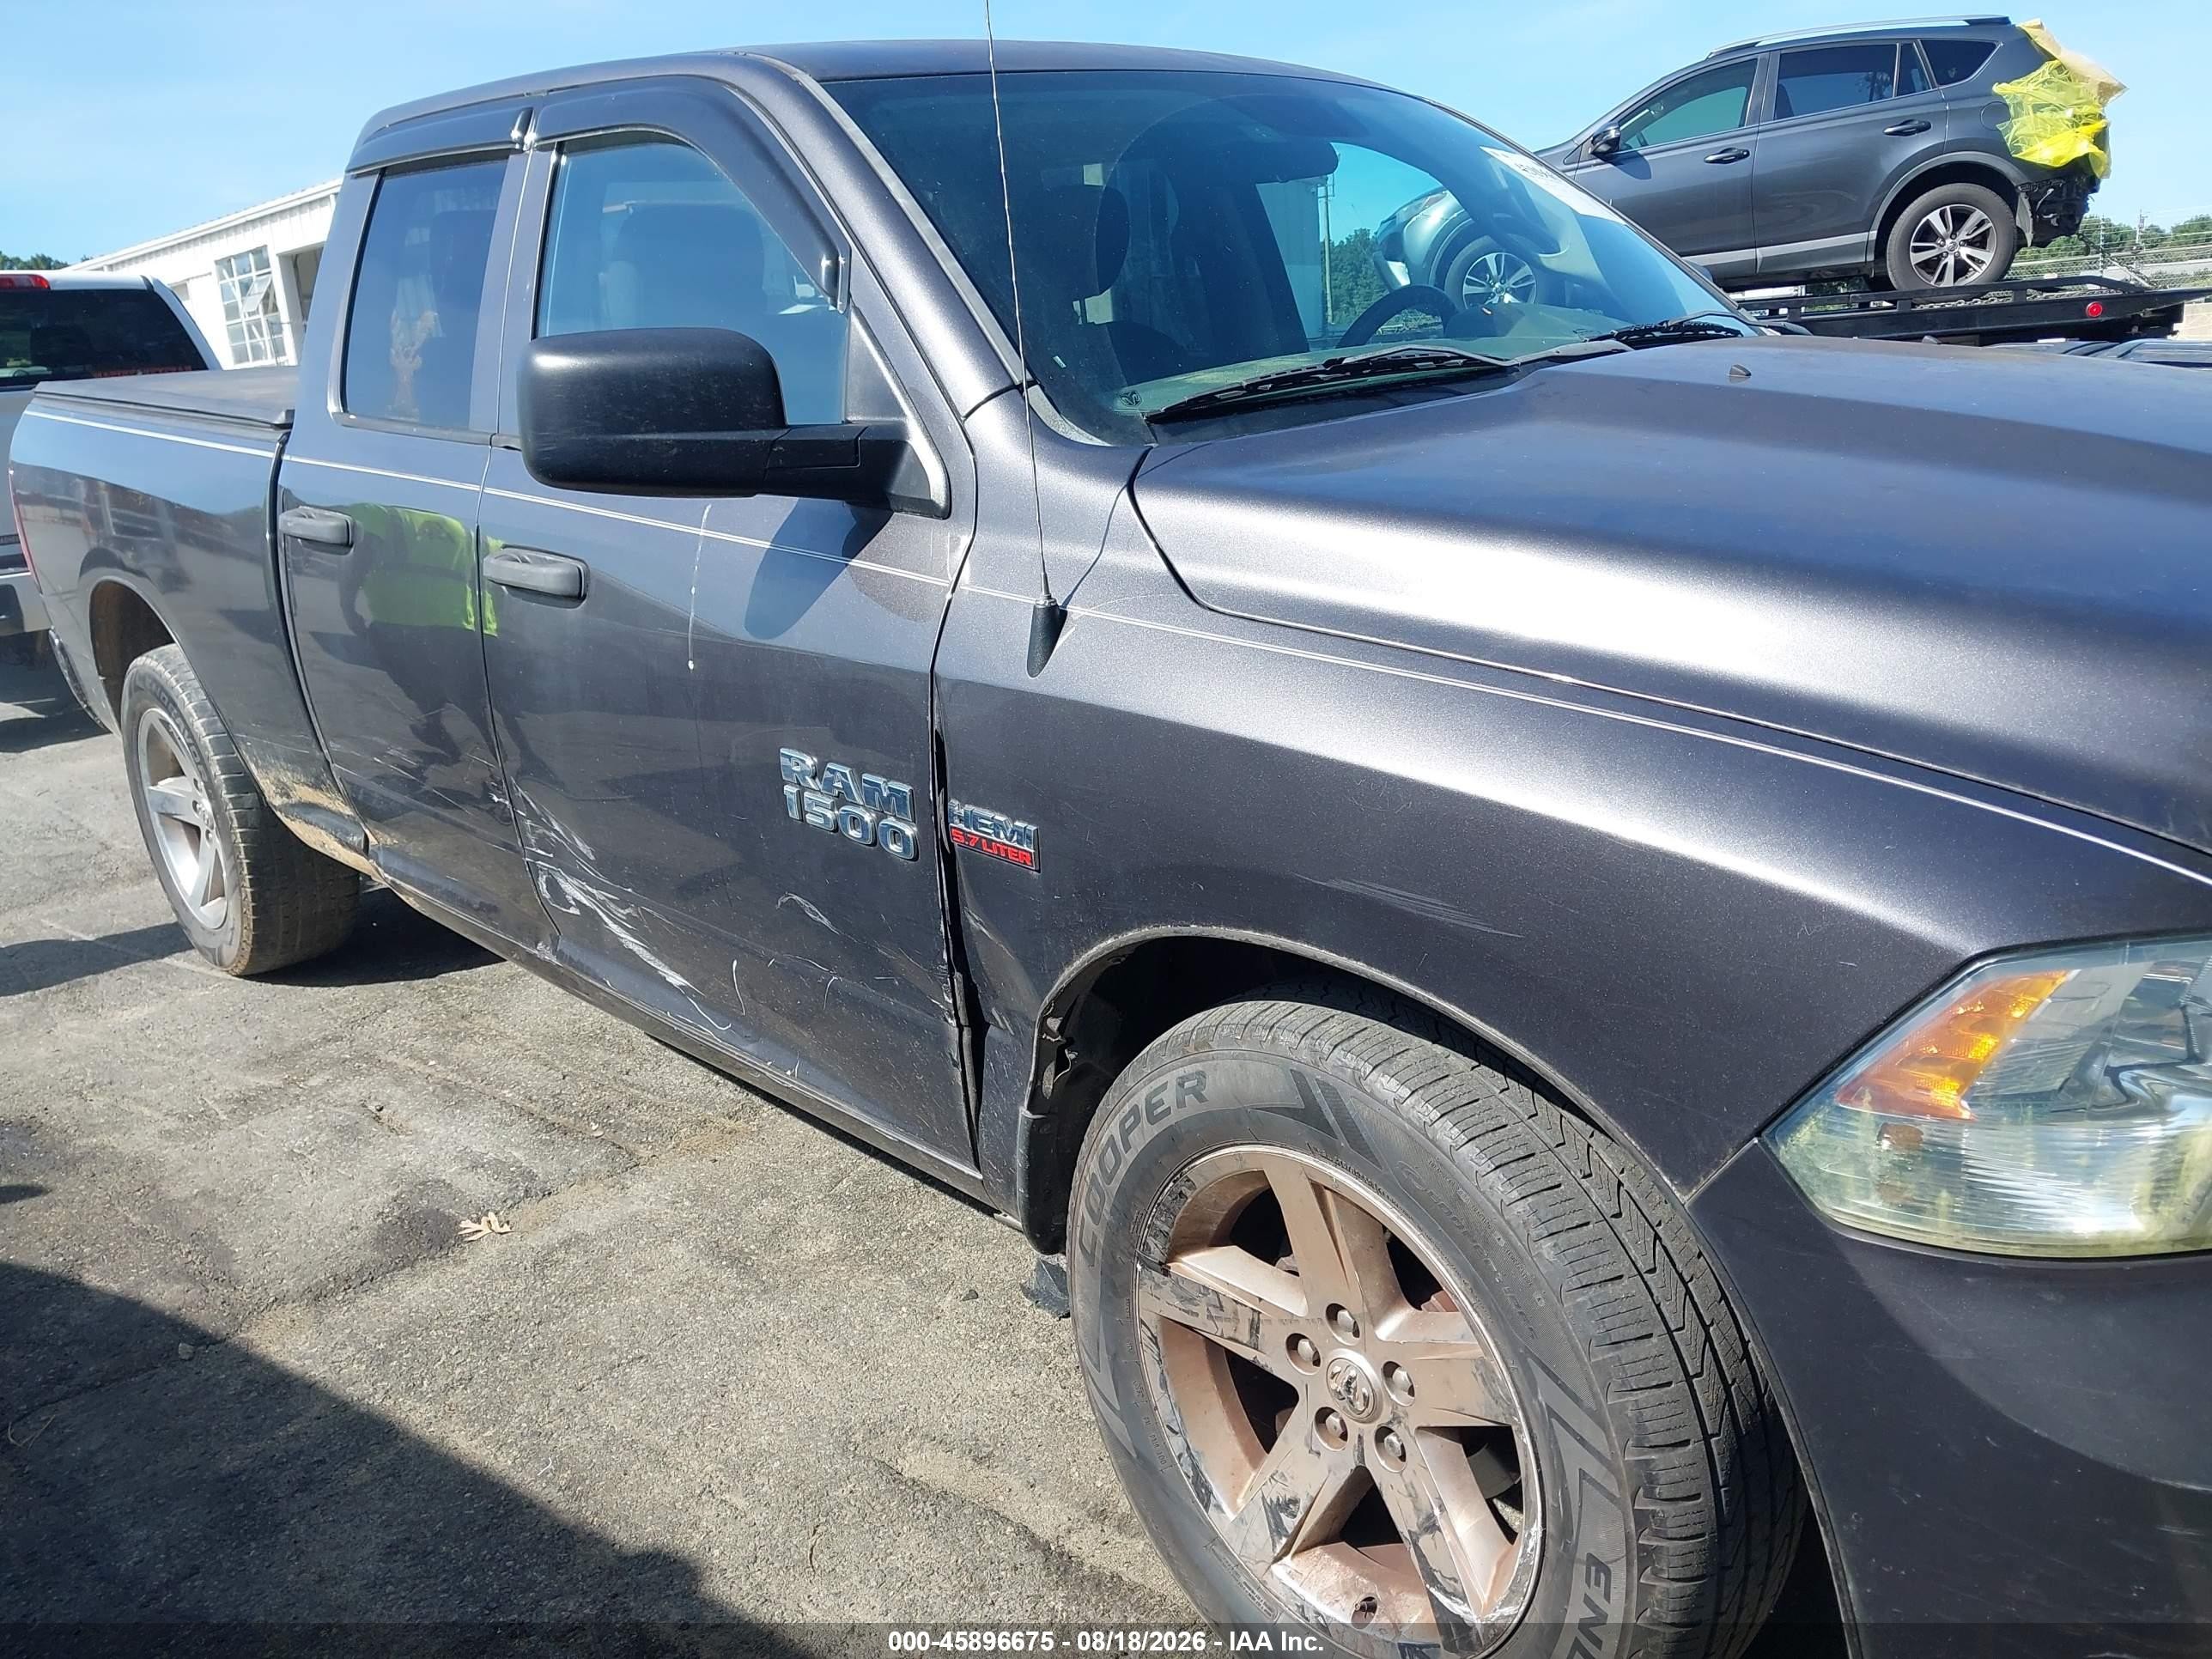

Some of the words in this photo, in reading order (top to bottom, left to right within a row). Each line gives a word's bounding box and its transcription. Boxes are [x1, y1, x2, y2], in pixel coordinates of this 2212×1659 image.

[780, 747, 916, 823] RAM
[782, 784, 919, 860] 1500
[948, 799, 1037, 848] HEMI
[951, 829, 979, 847] 5.7
[981, 838, 1032, 866] LITER
[1079, 1069, 1209, 1267] COOPER
